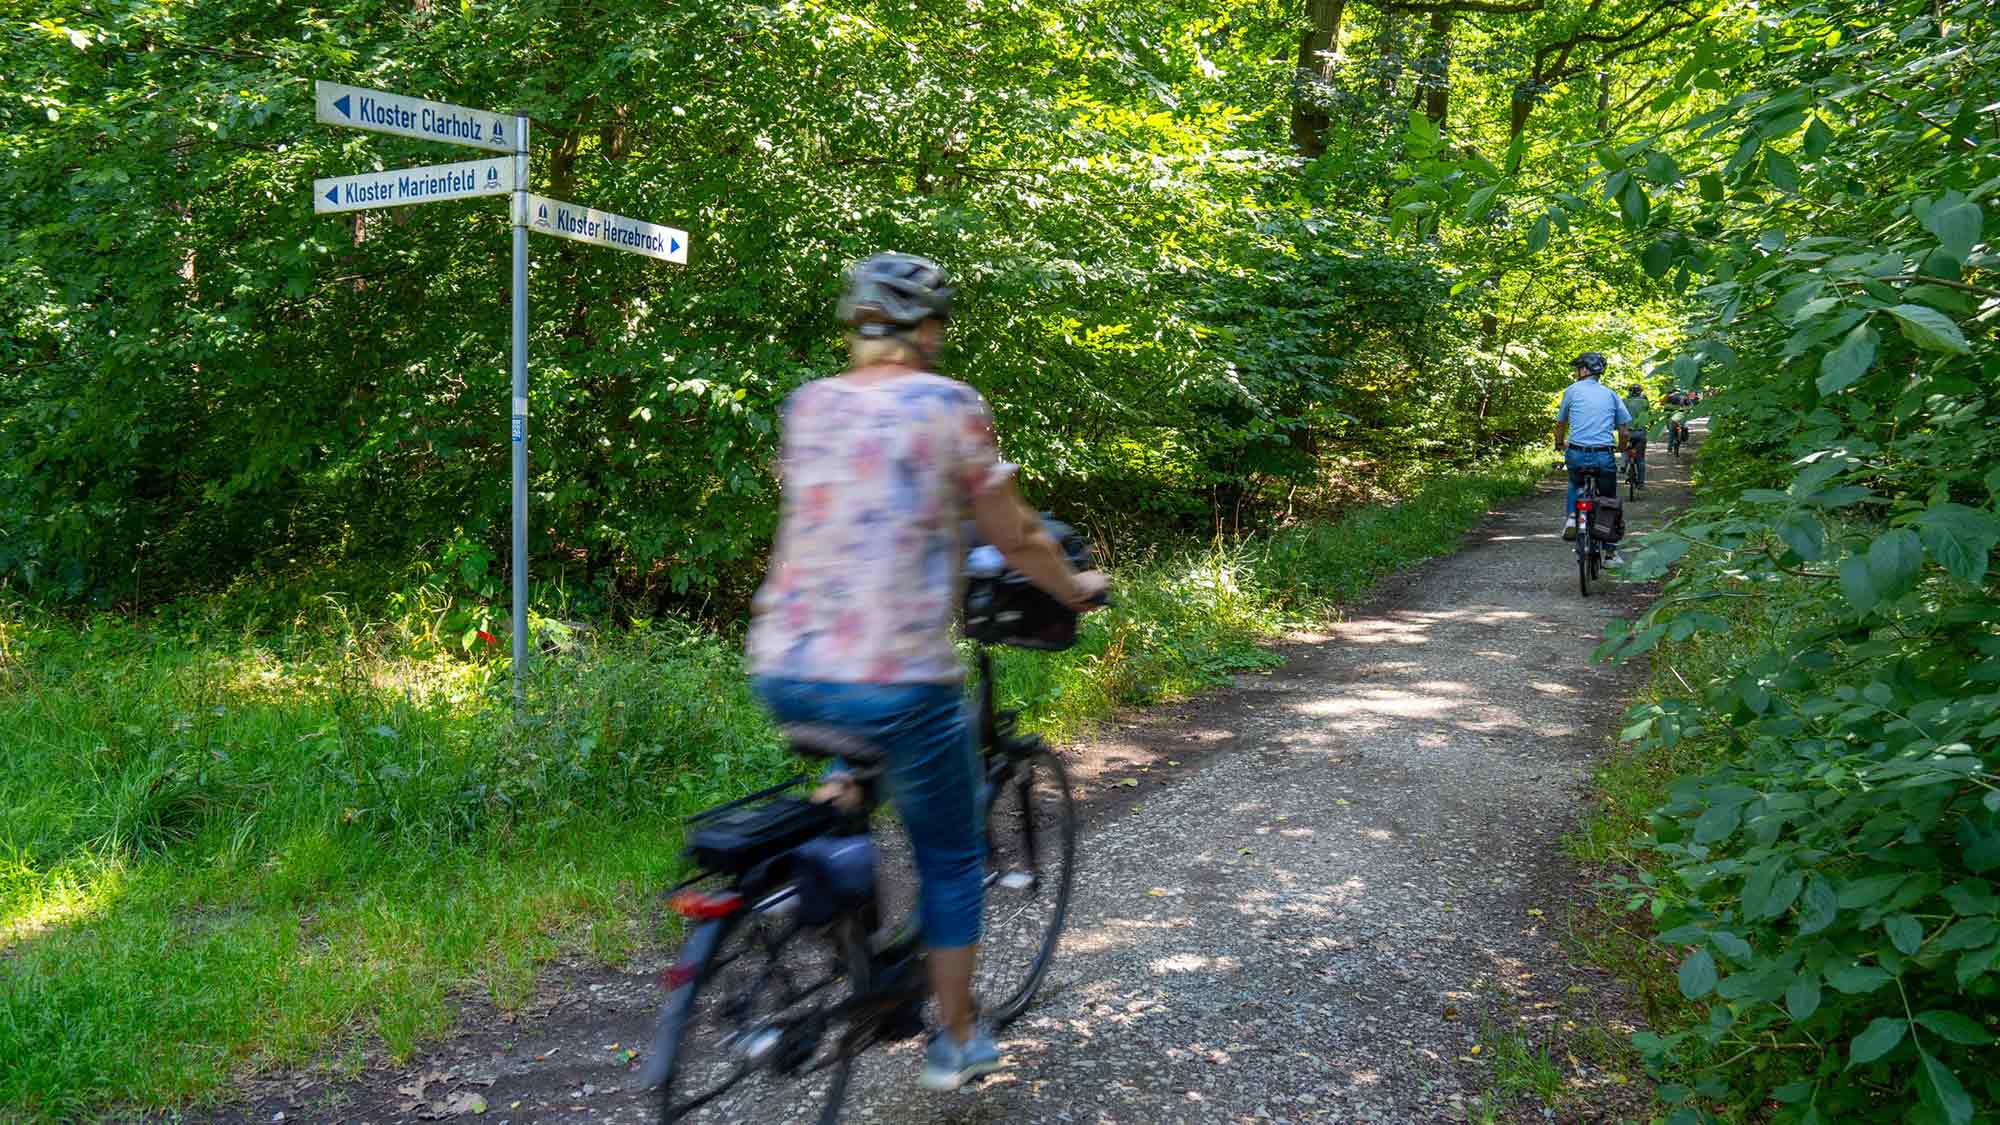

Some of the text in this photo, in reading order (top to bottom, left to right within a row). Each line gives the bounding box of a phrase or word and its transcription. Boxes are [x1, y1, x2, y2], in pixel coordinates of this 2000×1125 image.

[359, 96, 482, 140] Kloster Clarholz
[345, 169, 475, 203] Kloster Marienfeld
[557, 208, 664, 252] Kloster Herzebrock
